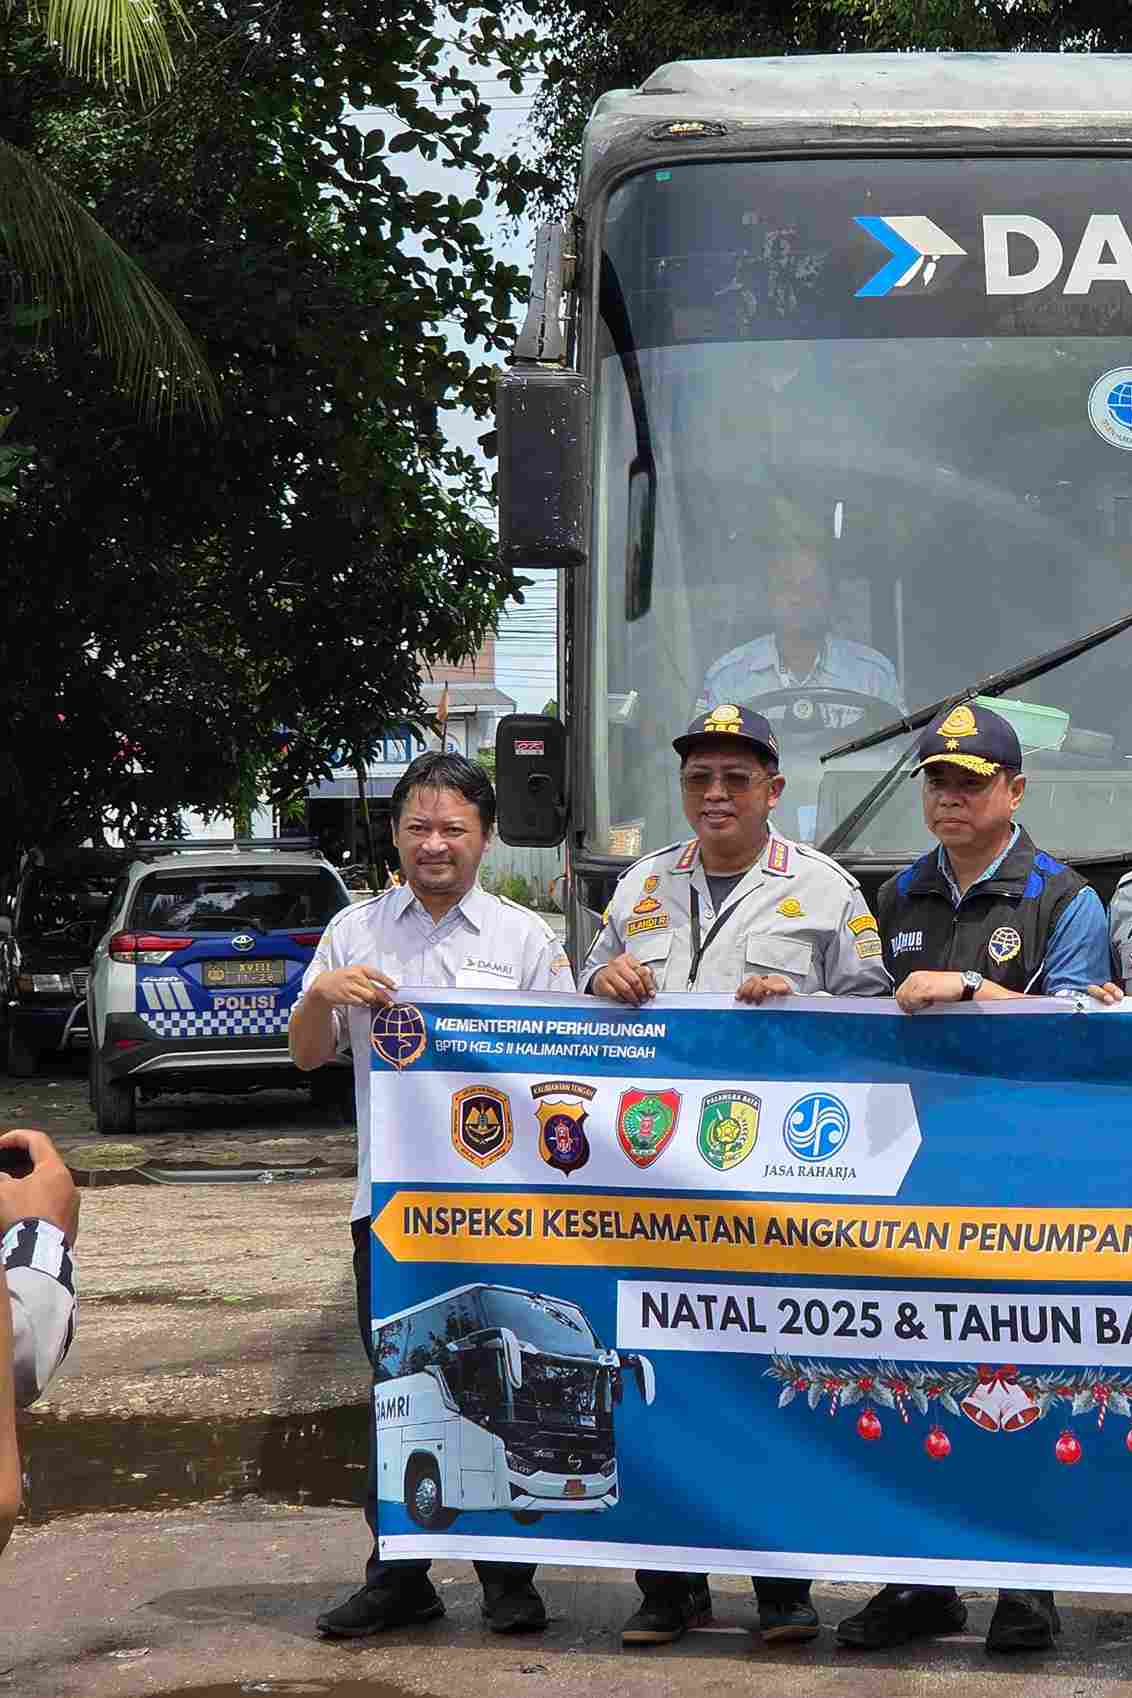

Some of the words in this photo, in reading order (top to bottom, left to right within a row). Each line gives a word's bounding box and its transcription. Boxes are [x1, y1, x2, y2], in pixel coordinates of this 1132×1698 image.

[478, 960, 513, 975] DAMRI
[213, 995, 276, 1010] POLISI
[435, 1017, 543, 1034] KEMENTERIAN
[546, 1020, 666, 1038] PERHUBUNGAN
[435, 1040, 467, 1053] BPTD
[469, 1041, 504, 1054] KELS
[516, 1043, 600, 1057] KALIMANTAN
[602, 1045, 656, 1058] TENGAH
[762, 1165, 794, 1178] JASA
[797, 1165, 857, 1181] RAHARJA
[403, 1207, 532, 1238] INSPEKSI
[543, 1209, 754, 1245] KESELAMATAN
[764, 1217, 948, 1250] ANGKUTAN
[641, 1292, 766, 1334] NATAL
[777, 1298, 882, 1338] 2025
[894, 1302, 928, 1341] &
[935, 1303, 1081, 1344] TAHUN
